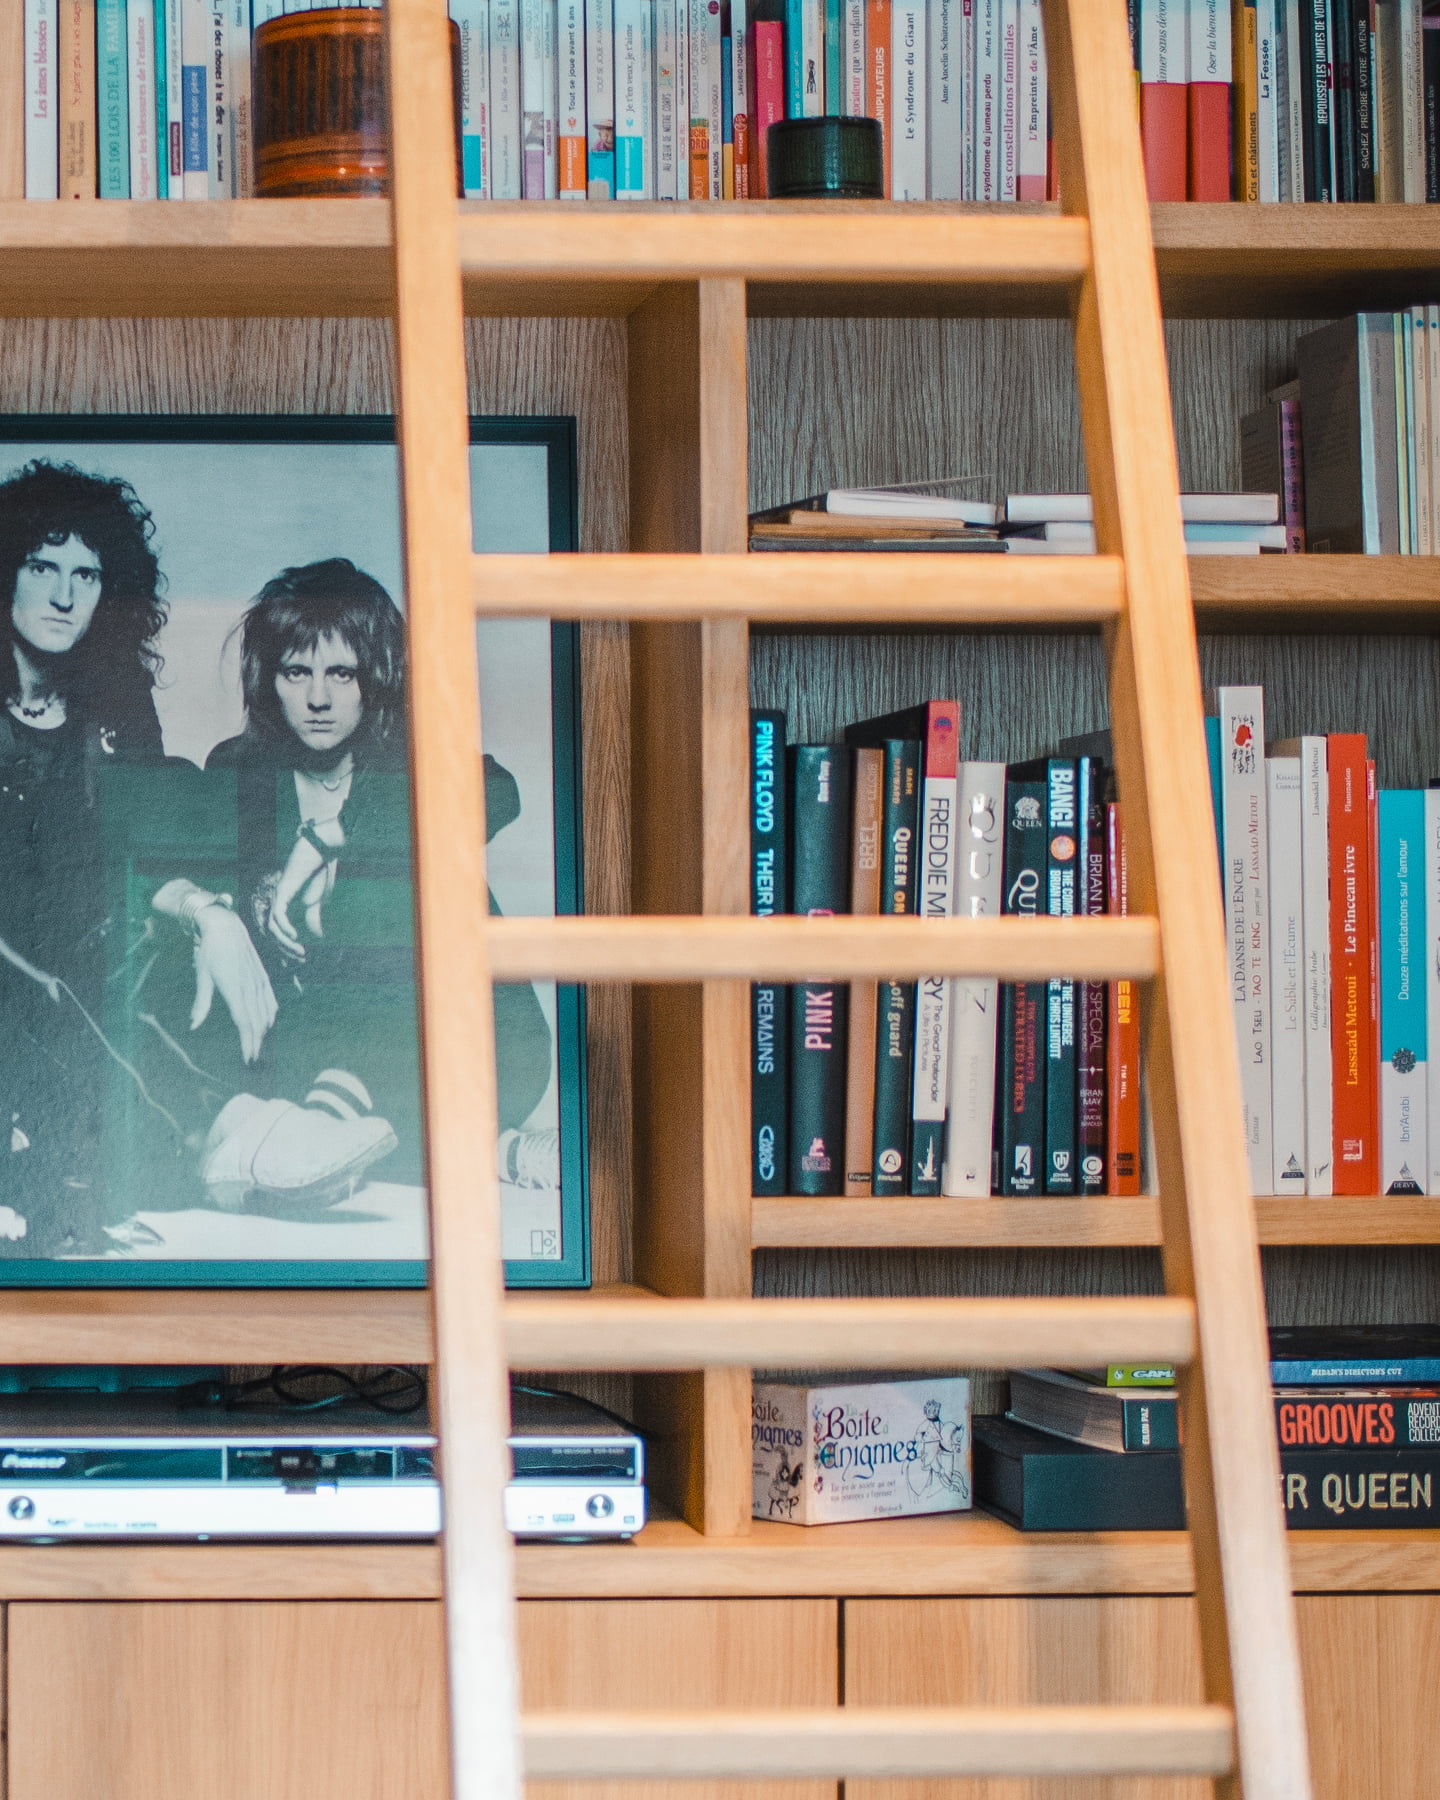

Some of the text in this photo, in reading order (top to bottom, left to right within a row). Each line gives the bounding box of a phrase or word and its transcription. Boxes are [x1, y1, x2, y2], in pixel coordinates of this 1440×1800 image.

[1315, 21, 1325, 30] DE
[1316, 32, 1326, 62] LIMITES
[33, 20, 47, 119] Les âmes blessées
[459, 19, 471, 111] Parents toxiques
[568, 58, 577, 77] joue
[569, 80, 575, 89] se
[904, 12, 915, 139] Le Syndrome du Gisant
[1028, 26, 1039, 141] L'Empreinte de l'Âme
[1260, 39, 1270, 98] La Fessée
[1316, 64, 1327, 77] LES
[1003, 24, 1014, 196] Les constellations familiales
[1317, 79, 1328, 124] REPOUSSEZ
[1358, 20, 1370, 169] SACHEZ PRÉDIRE VOTRE AVENIR
[983, 74, 993, 192] syndrome du jumeau perdu
[1248, 112, 1257, 201] Cris et châtiments
[756, 721, 773, 832] PINK FLOYD
[1050, 769, 1074, 828] BANG!
[1344, 767, 1354, 812] Flammarion
[859, 821, 877, 869] BREL
[928, 797, 950, 886] FREDDIE
[757, 849, 773, 905] THEIR
[1050, 870, 1061, 916] BRIAN MAY
[1089, 854, 1102, 901] BRIAN
[1343, 845, 1357, 953] Le Pinceau ivre
[1232, 858, 1247, 1003] LA DANSE DE L'ENCRE
[1251, 921, 1261, 949] KING
[1396, 838, 1410, 1000] Douze méditations sur l'amour
[1251, 956, 1261, 969] TE
[1252, 975, 1262, 997] TAO
[1286, 967, 1296, 978] et
[1309, 950, 1320, 1031] Calligraphie Arabe
[804, 990, 833, 1050] PINK
[887, 987, 904, 1057] off guard
[1061, 985, 1073, 1046] THE UNIVERSE
[1088, 992, 1103, 1053] SPECIAL
[1252, 1010, 1262, 1035] TSEU
[1284, 980, 1297, 1013] Sable
[1285, 1015, 1297, 1030] Le
[1344, 975, 1358, 1027] Metoui
[931, 1004, 943, 1103] The Great Pretender
[1049, 996, 1061, 1059] CHRIS LINTOTT
[1253, 1042, 1263, 1064] LAO
[1399, 1096, 1411, 1143] Ibn'Arabi
[1279, 1403, 1395, 1445] GROOVES
[1321, 1473, 1431, 1514] QUEEN
